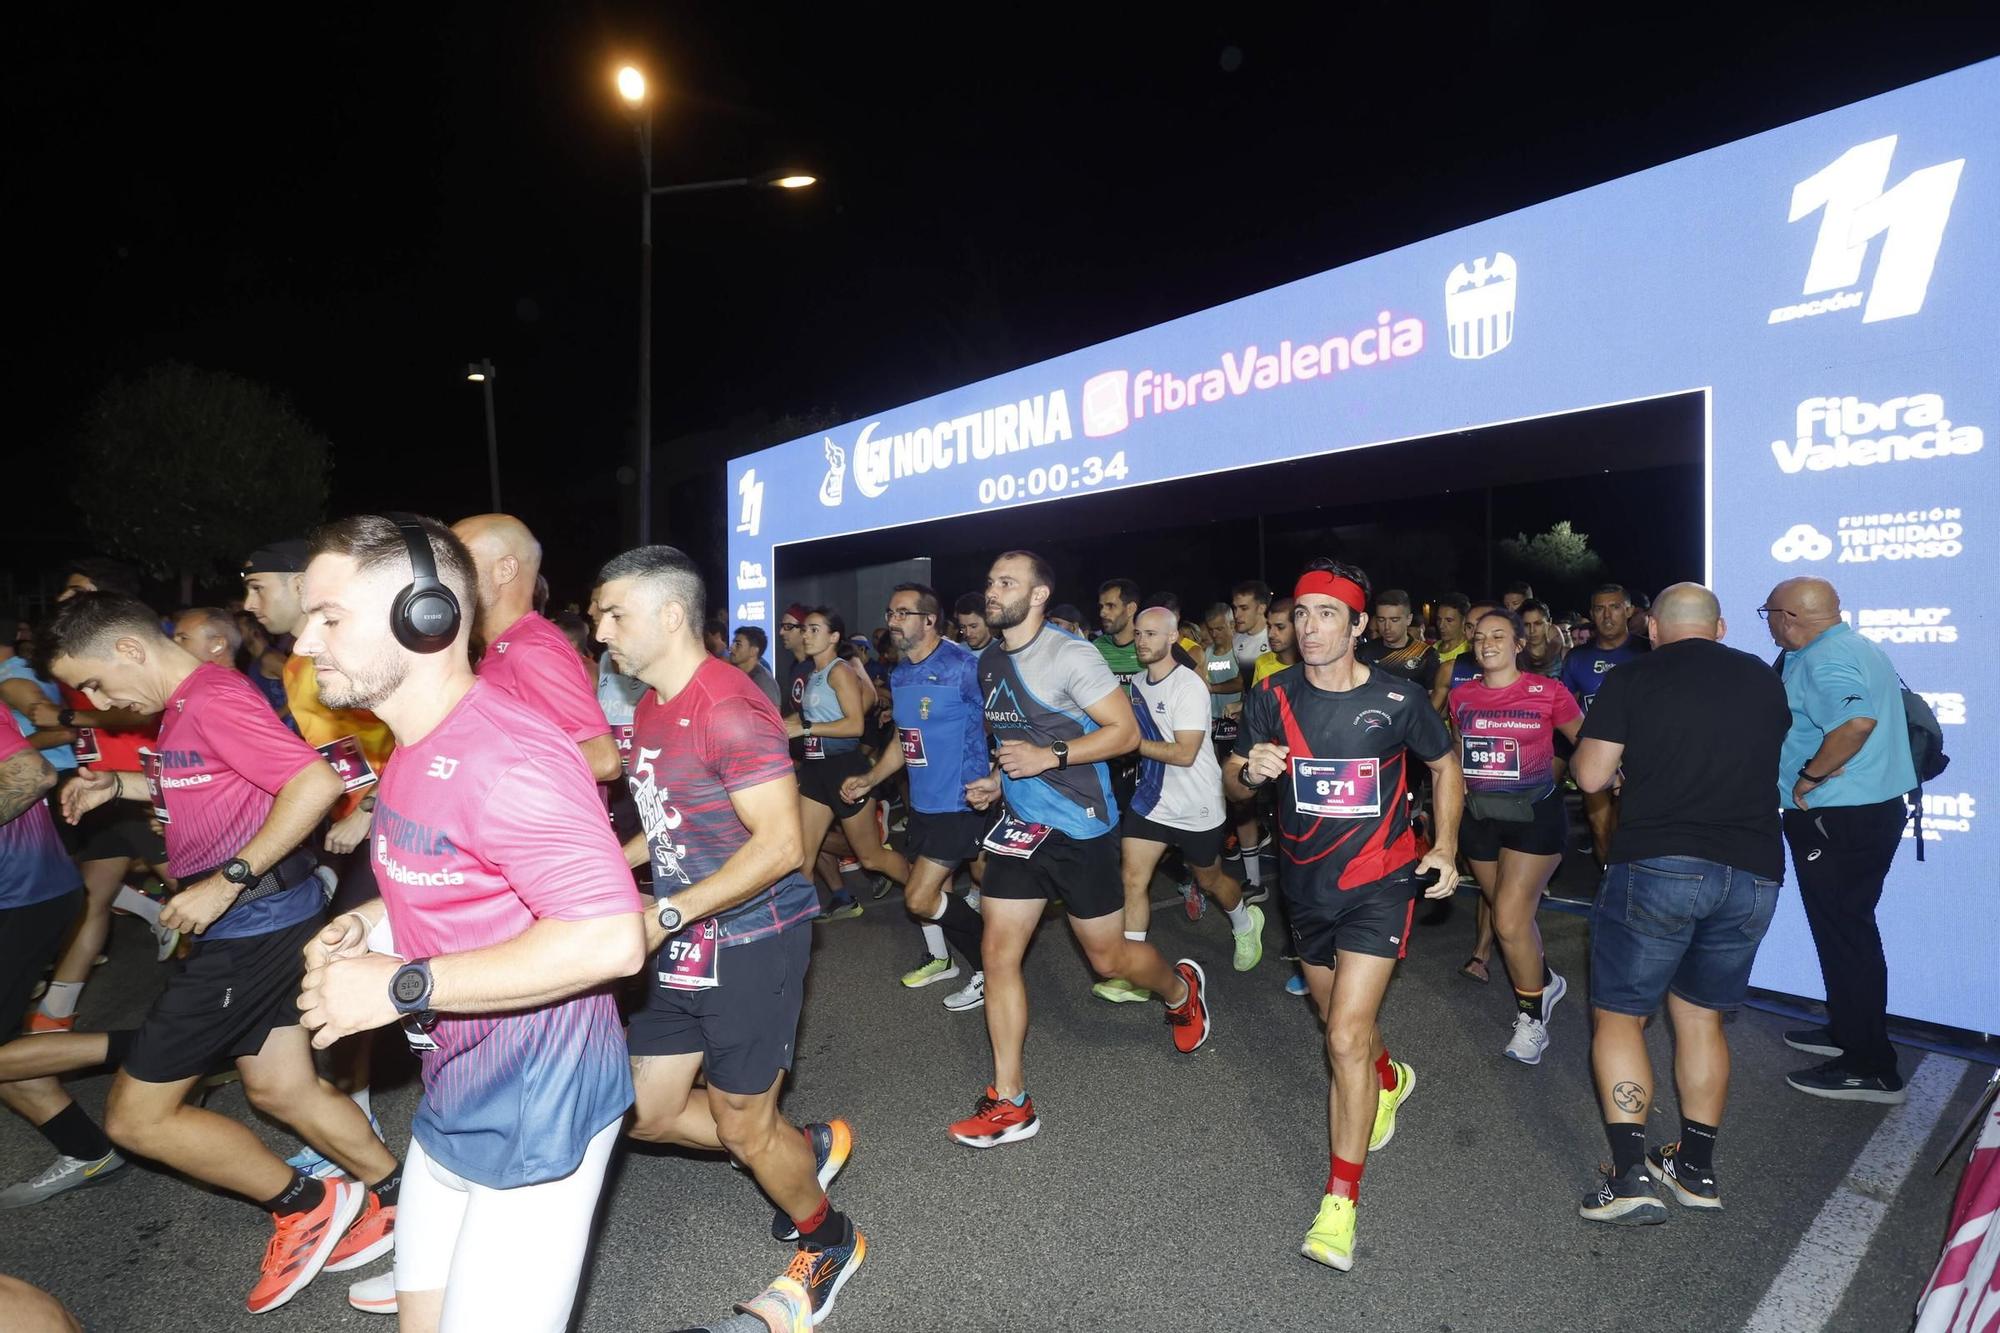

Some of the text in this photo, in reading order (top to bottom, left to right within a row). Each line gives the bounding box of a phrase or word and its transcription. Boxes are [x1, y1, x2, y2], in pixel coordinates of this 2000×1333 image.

[1788, 134, 1966, 324] 11
[894, 389, 1073, 479] NOCTURNA
[1133, 310, 1425, 419] fibraValencia
[1796, 393, 1945, 438] Fibra
[1770, 419, 1984, 474] Valencia
[978, 451, 1129, 504] 00:00:34
[1838, 507, 1962, 528] FUNDACIÓN
[1837, 522, 1964, 546] TRINIDAD
[1837, 540, 1964, 563] ALFONSO
[1207, 661, 1231, 671] HOKA
[1471, 751, 1506, 763] 9818
[160, 774, 212, 789] alencia
[1316, 780, 1355, 796] 871
[376, 802, 457, 856] TURNA
[669, 940, 702, 963] 574
[281, 1177, 306, 1204] FILA
[376, 1177, 401, 1195] FILA
